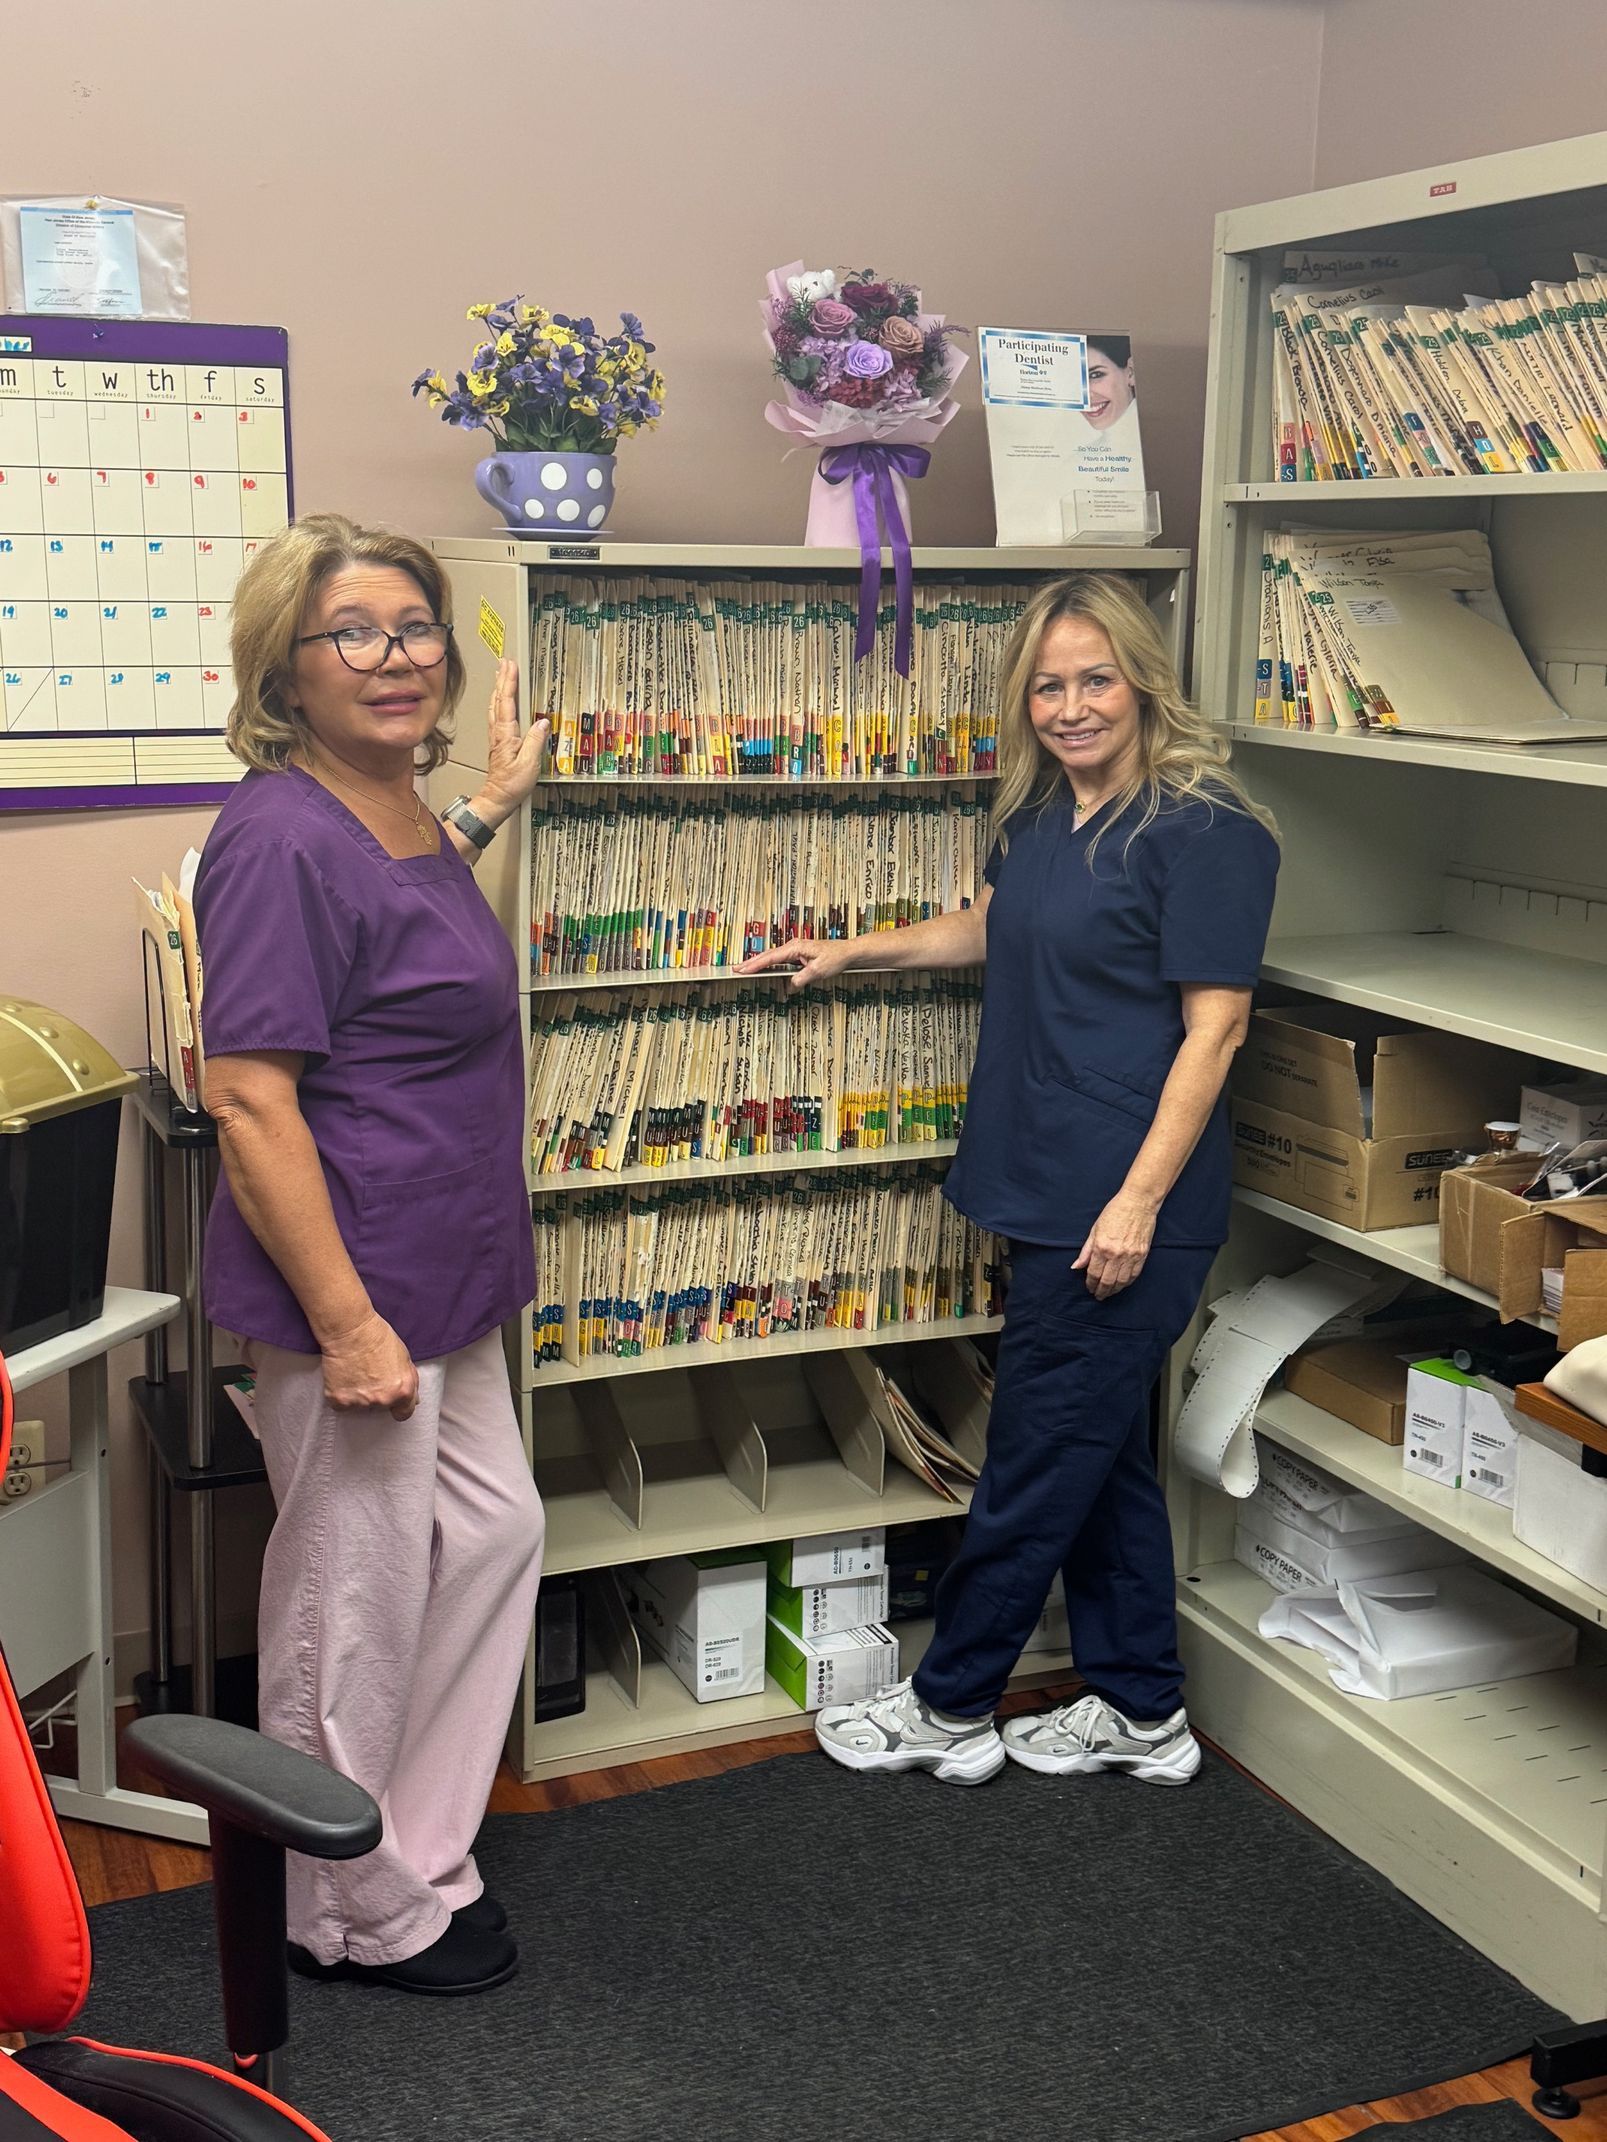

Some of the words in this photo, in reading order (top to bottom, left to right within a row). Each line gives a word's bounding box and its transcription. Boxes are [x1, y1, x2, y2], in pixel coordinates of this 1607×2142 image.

[1307, 293, 1356, 309] Cornelius
[1563, 308, 1574, 320] 25
[1590, 303, 1603, 316] 25
[998, 338, 1069, 355] Participating
[1426, 337, 1439, 348] 25
[1015, 353, 1054, 366] Dentist
[1318, 331, 1345, 386] Cornelius
[1488, 346, 1512, 377] Khan
[0, 368, 16, 386] m
[52, 366, 67, 388] t
[102, 372, 117, 390] w
[146, 368, 174, 392] th
[204, 371, 217, 393] f
[254, 378, 265, 394] s
[145, 408, 150, 419] 1
[239, 411, 248, 422] 3
[1284, 448, 1294, 460] A
[47, 473, 57, 484] 6
[97, 471, 106, 483] 7
[1285, 468, 1294, 480] S
[194, 475, 205, 488] 9
[242, 478, 256, 489] 10
[198, 541, 212, 552] 16
[1320, 594, 1332, 604] 25
[2, 606, 14, 618] 19
[54, 607, 68, 618] 20
[104, 606, 117, 619] 21
[152, 607, 167, 618] 22
[198, 607, 212, 617] 23
[621, 603, 631, 615] 26
[950, 609, 960, 620] 26
[570, 610, 579, 622] 26
[586, 615, 596, 627] 26
[794, 615, 805, 628] 26
[702, 617, 713, 630] 26
[1262, 663, 1269, 675] S
[5, 672, 21, 684] 26
[156, 672, 171, 684] 29
[202, 671, 219, 681] 30
[644, 668, 654, 711] Galina
[1262, 683, 1269, 694] T
[865, 860, 874, 900] Enrico
[169, 933, 178, 946] 26
[648, 1009, 657, 1020] 26
[734, 1057, 743, 1095] Susan
[923, 1056, 933, 1089] Samuel
[1274, 1065, 1290, 1078] NOT
[618, 1070, 636, 1120] Michael
[1267, 1132, 1292, 1154] #10
[793, 1191, 803, 1203] 26
[1277, 1455, 1296, 1474] COPY
[1260, 1546, 1280, 1566] COPY
[1279, 1559, 1302, 1582] PAPER
